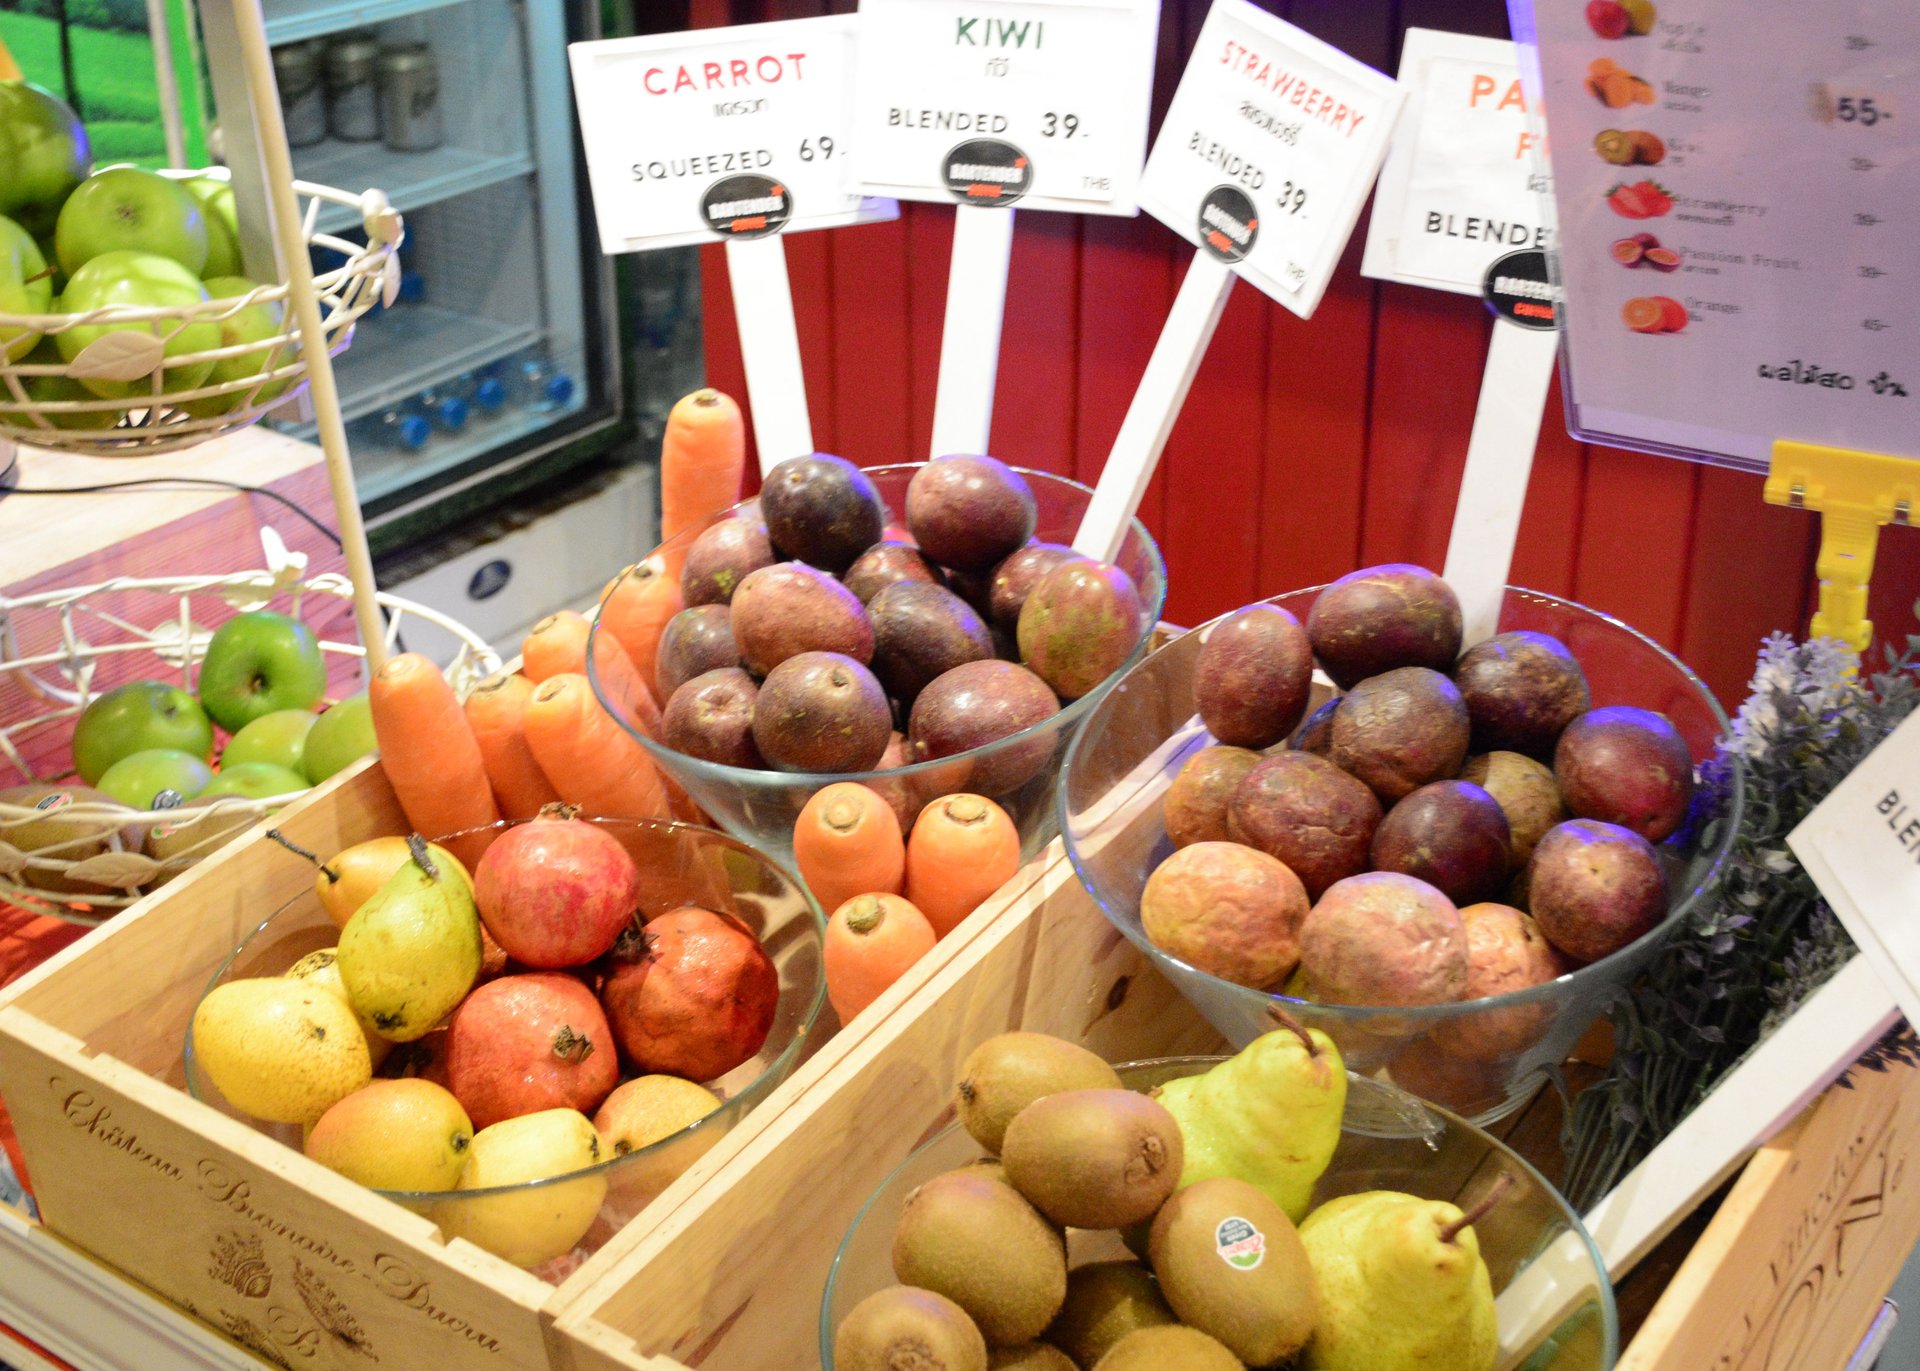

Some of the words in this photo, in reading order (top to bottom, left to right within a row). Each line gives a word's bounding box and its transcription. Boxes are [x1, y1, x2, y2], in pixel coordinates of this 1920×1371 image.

[955, 17, 1044, 49] KIWI
[643, 53, 807, 96] CARROT
[1217, 40, 1365, 138] STRAWBERRY
[888, 107, 1009, 133] BLENDED
[631, 149, 773, 182] SQUEEZED
[1188, 131, 1266, 191] BLENDED
